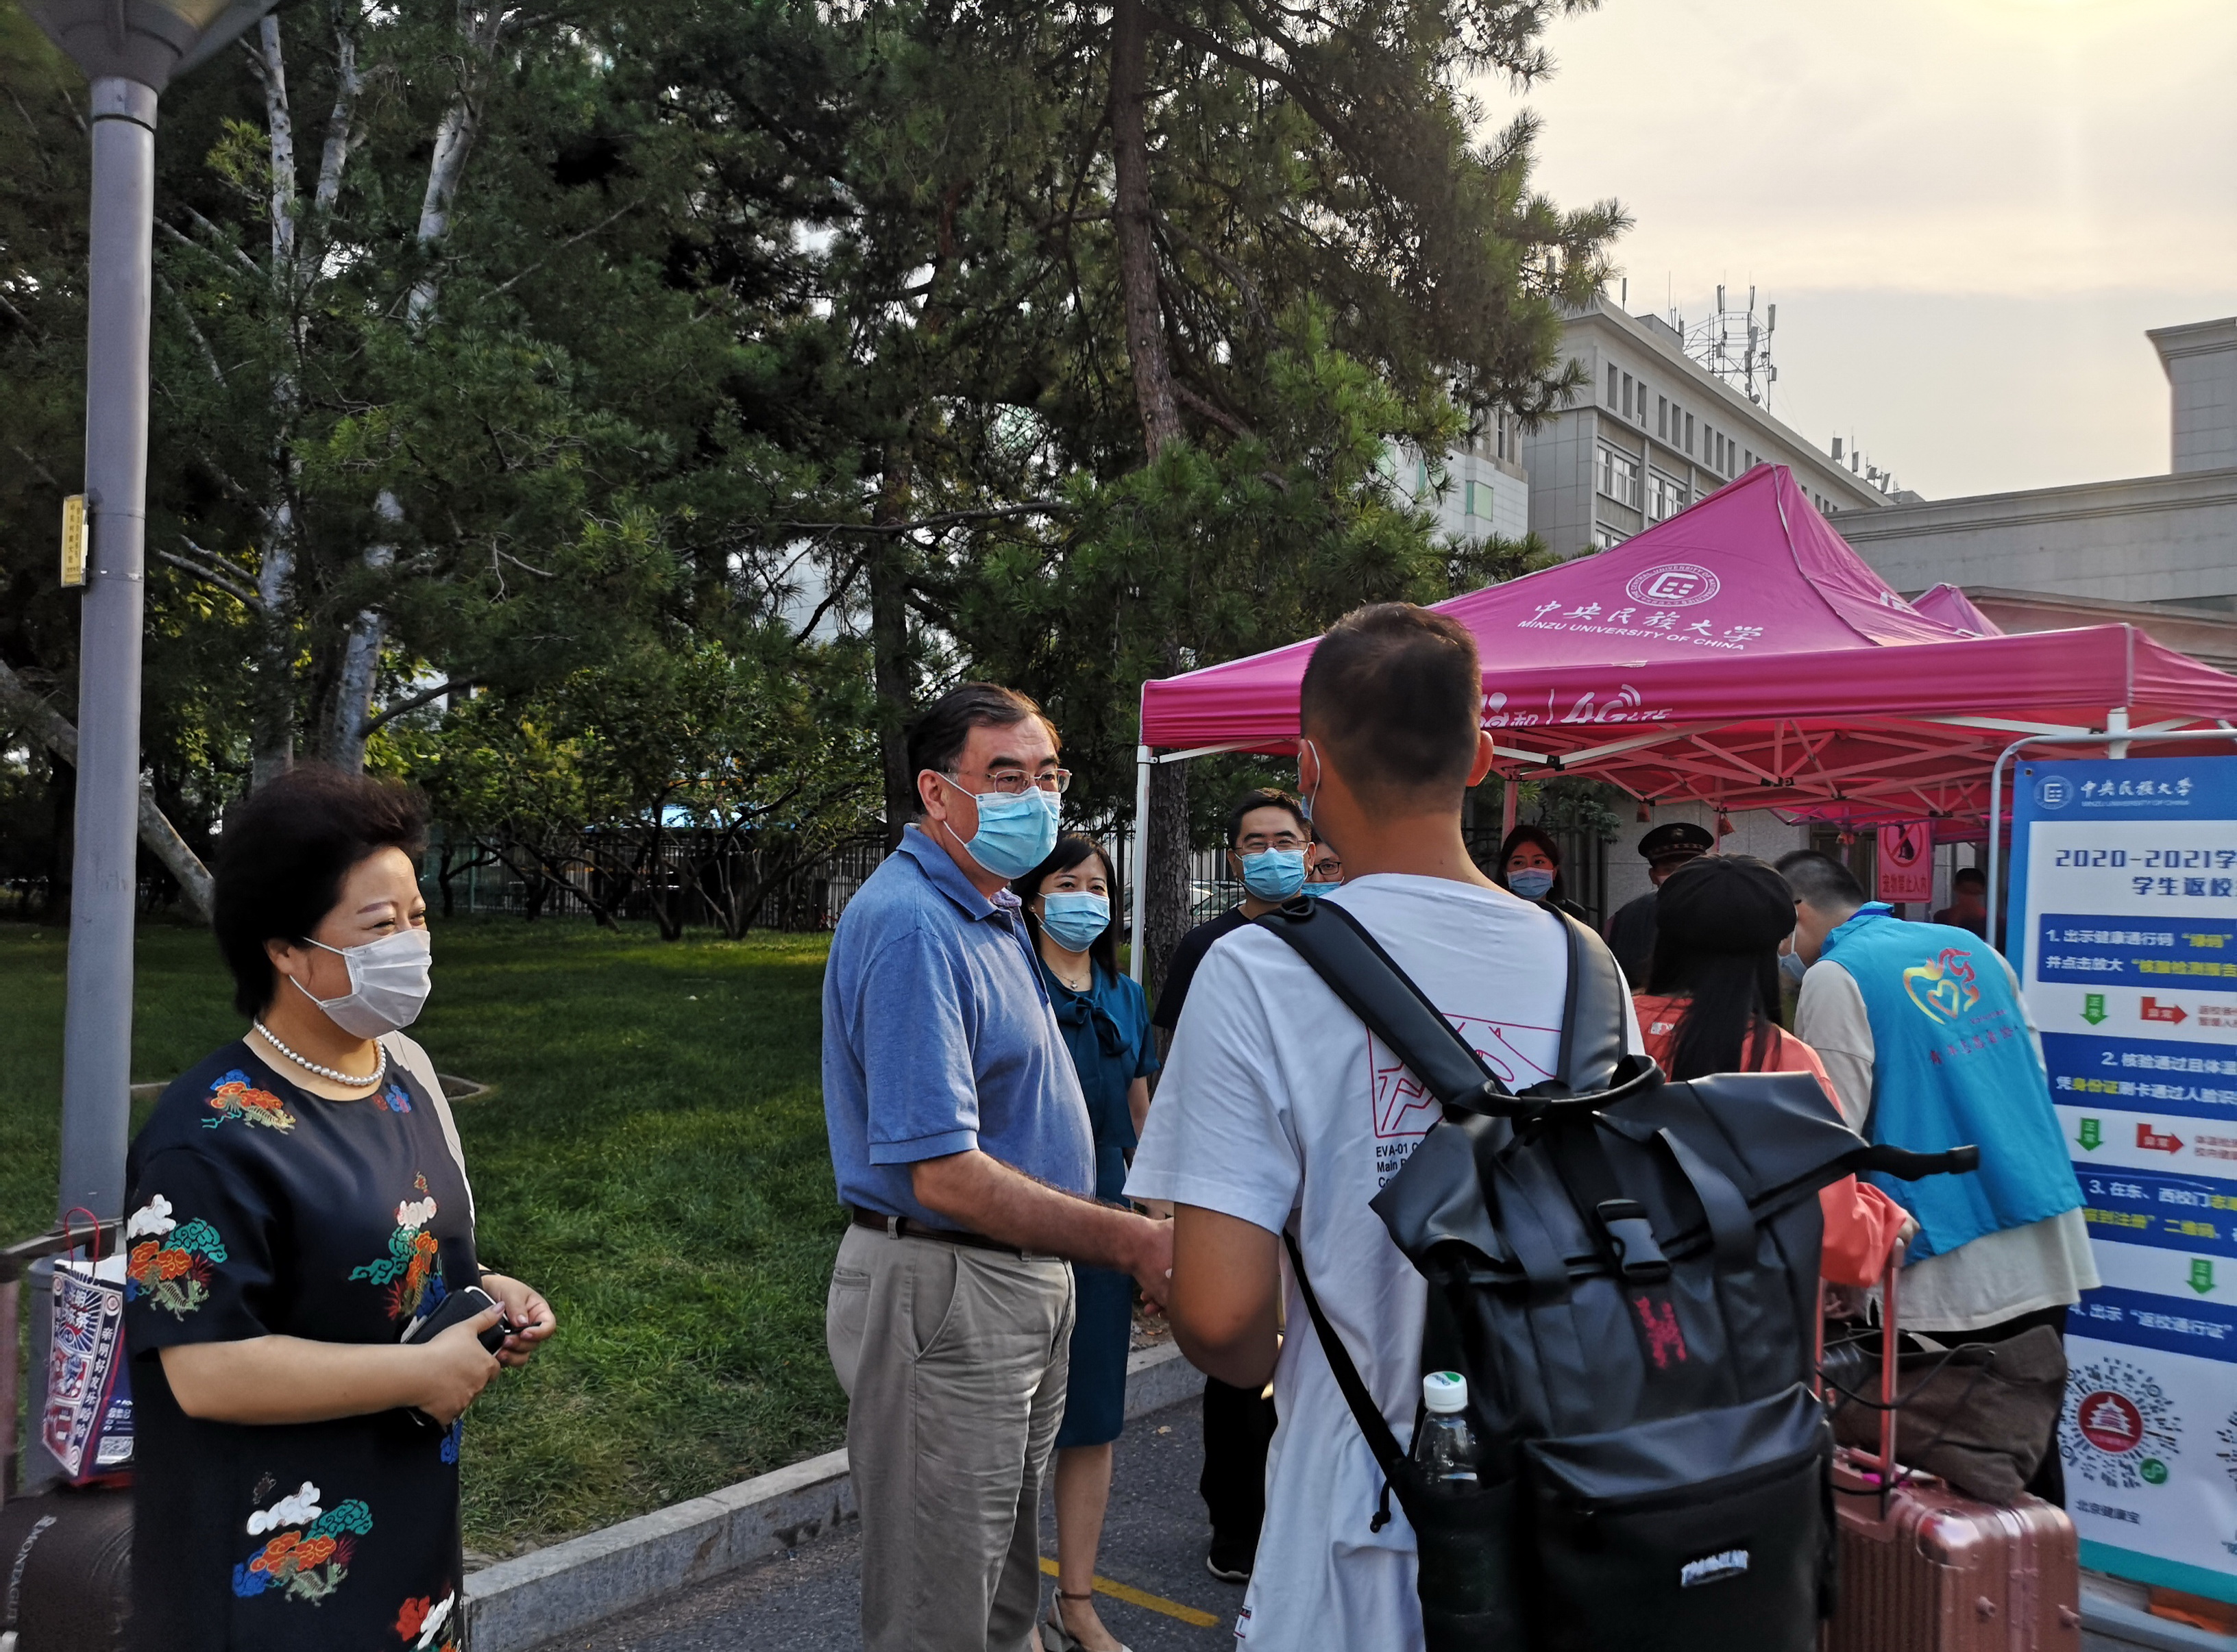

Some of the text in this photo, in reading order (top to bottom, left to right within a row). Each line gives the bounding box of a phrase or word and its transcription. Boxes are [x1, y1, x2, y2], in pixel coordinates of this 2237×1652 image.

[1535, 600, 1764, 642] 中央民族大学
[1517, 620, 1744, 650] MINZU UNIVERSITY OF CHINA
[2080, 776, 2193, 799] 中央民族大学
[2056, 850, 2237, 870] 2020-2021学
[2132, 876, 2237, 898] 学生返校
[1376, 1143, 1408, 1158] EVA-01
[1377, 1159, 1398, 1173] Main
